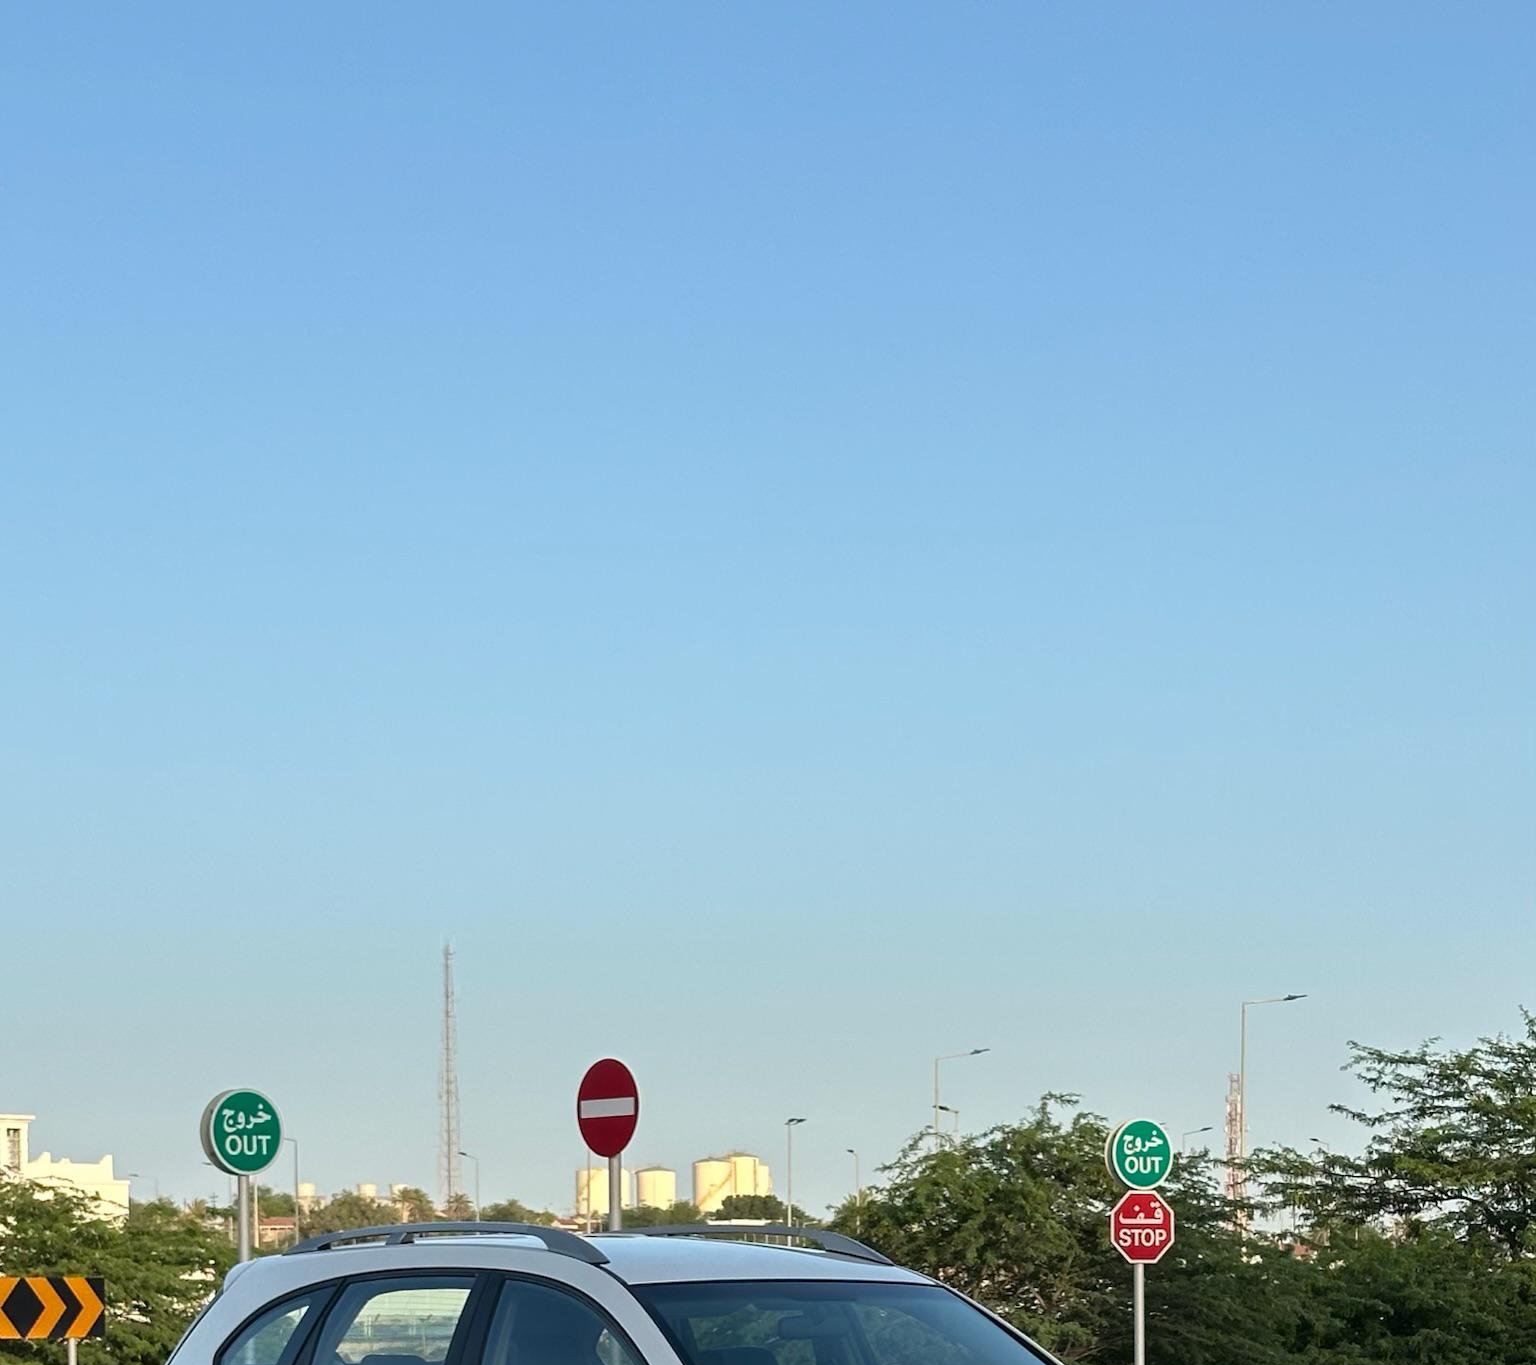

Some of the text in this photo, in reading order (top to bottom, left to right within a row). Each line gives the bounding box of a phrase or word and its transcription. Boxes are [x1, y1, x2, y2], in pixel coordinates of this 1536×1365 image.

[222, 1103, 271, 1133] خروج
[225, 1134, 271, 1155] OUT
[1123, 1130, 1163, 1155] خروج
[1125, 1156, 1163, 1174] OUT
[1119, 1201, 1163, 1225] قف
[1119, 1228, 1167, 1247] STOP
